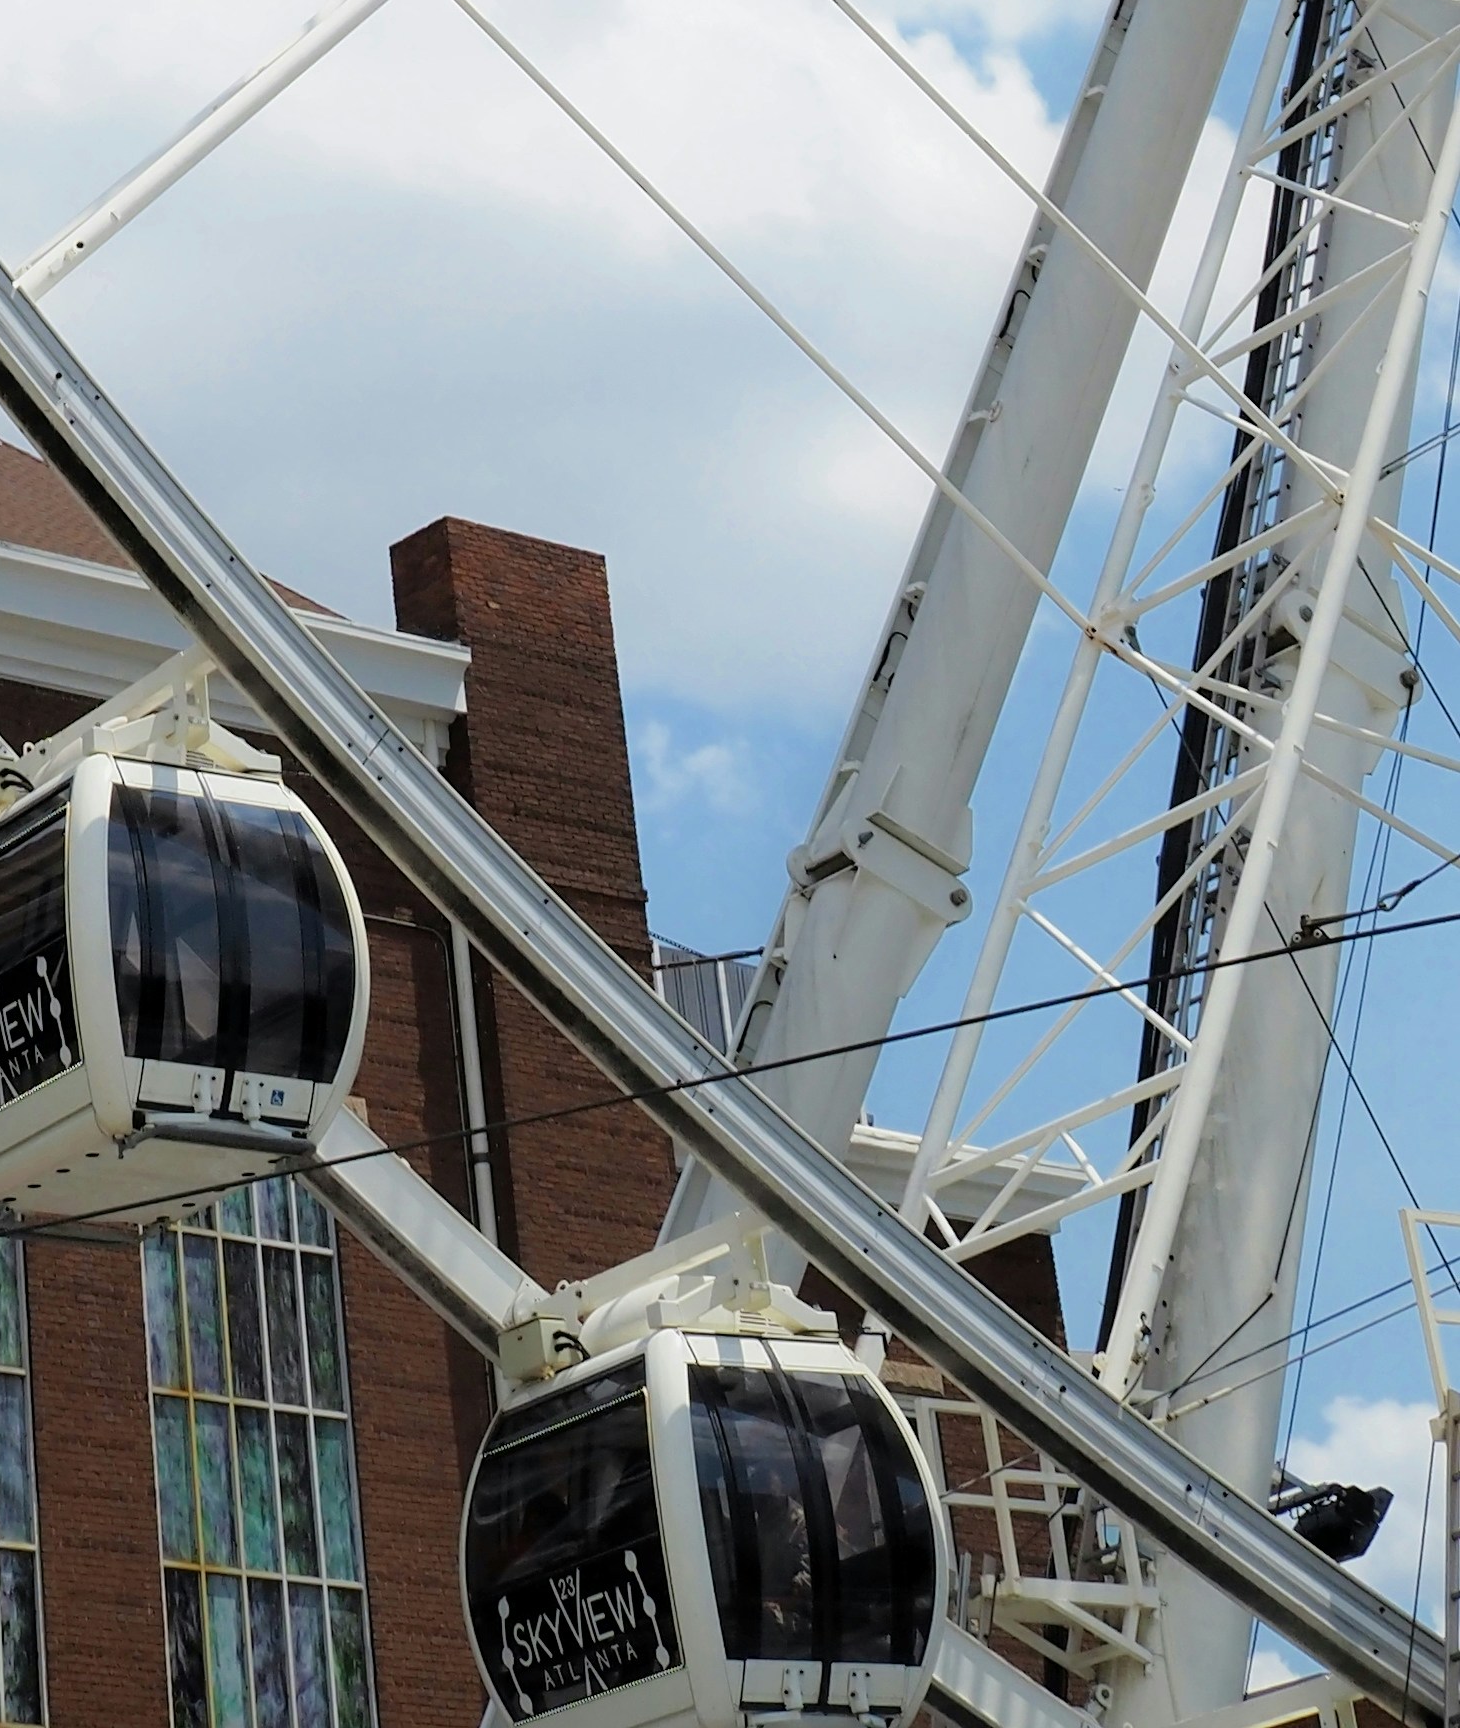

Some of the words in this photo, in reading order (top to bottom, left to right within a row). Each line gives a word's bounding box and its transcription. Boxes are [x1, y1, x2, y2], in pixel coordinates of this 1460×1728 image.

[558, 1575, 575, 1600] 23
[513, 1567, 636, 1667] SKYVIEW
[543, 1639, 637, 1696] ATLANTA
